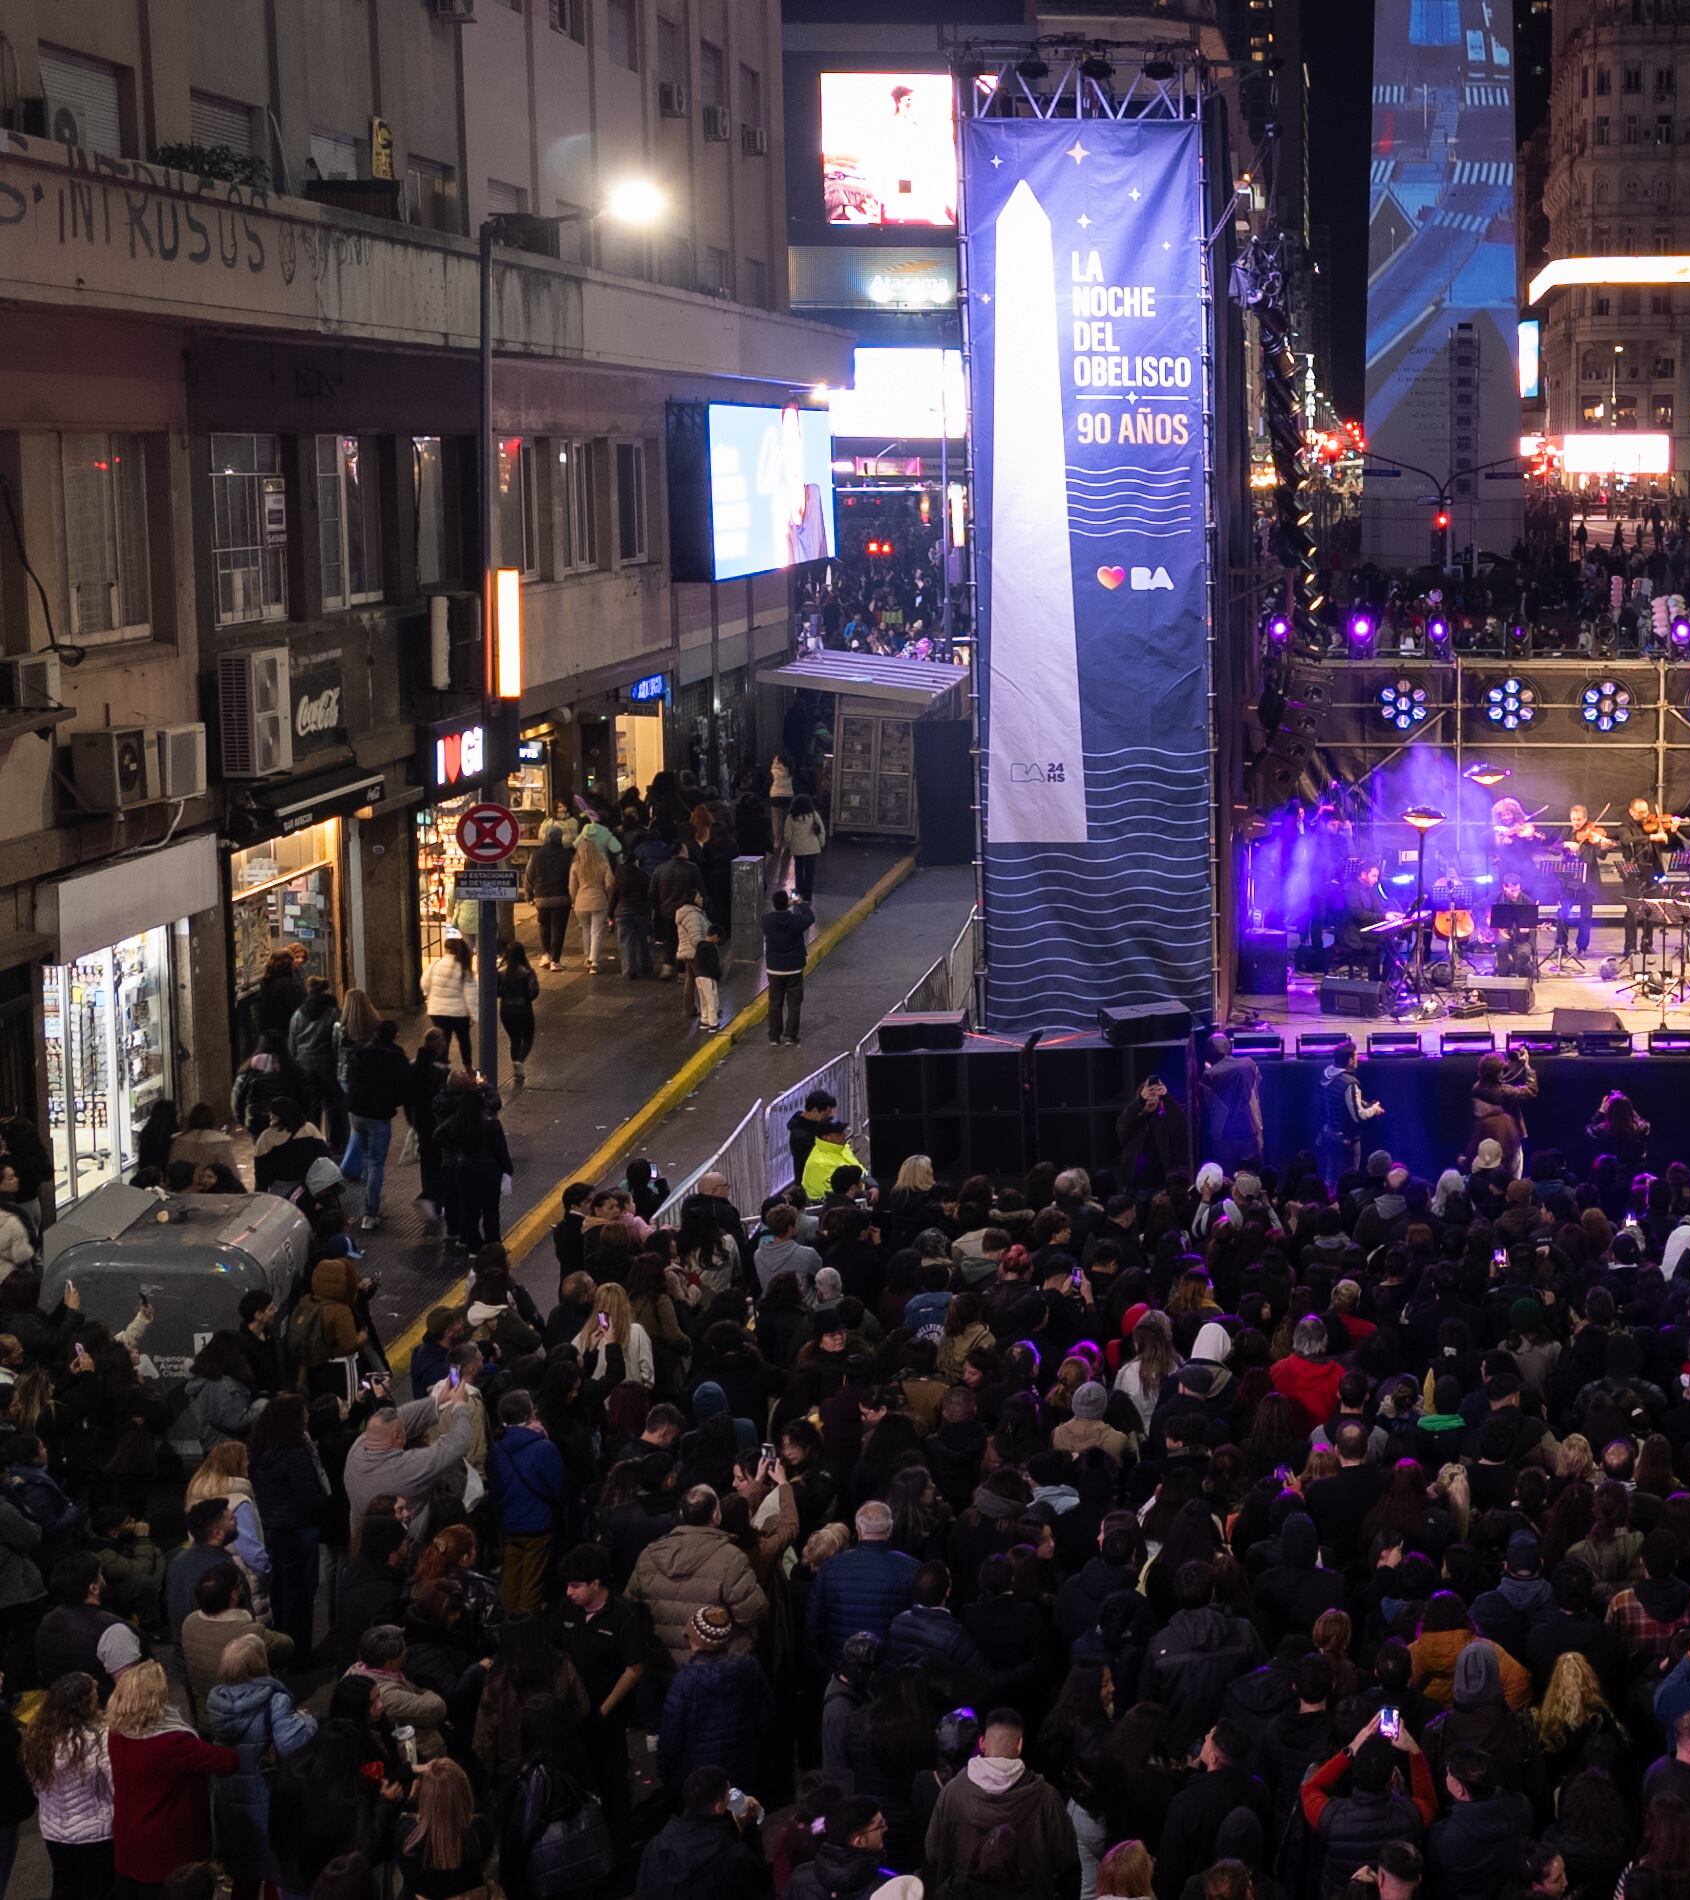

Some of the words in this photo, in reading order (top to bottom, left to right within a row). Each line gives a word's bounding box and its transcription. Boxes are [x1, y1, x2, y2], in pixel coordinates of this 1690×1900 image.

[1072, 251, 1104, 282] LA
[1072, 286, 1156, 317] NOCHE
[1073, 321, 1120, 352] DEL
[1074, 355, 1192, 388] OBELISCO
[1077, 412, 1112, 445] 90
[1118, 407, 1189, 445] AÑOS
[1130, 566, 1174, 590] BA
[1047, 763, 1064, 773] 24
[1047, 773, 1065, 782] HS
